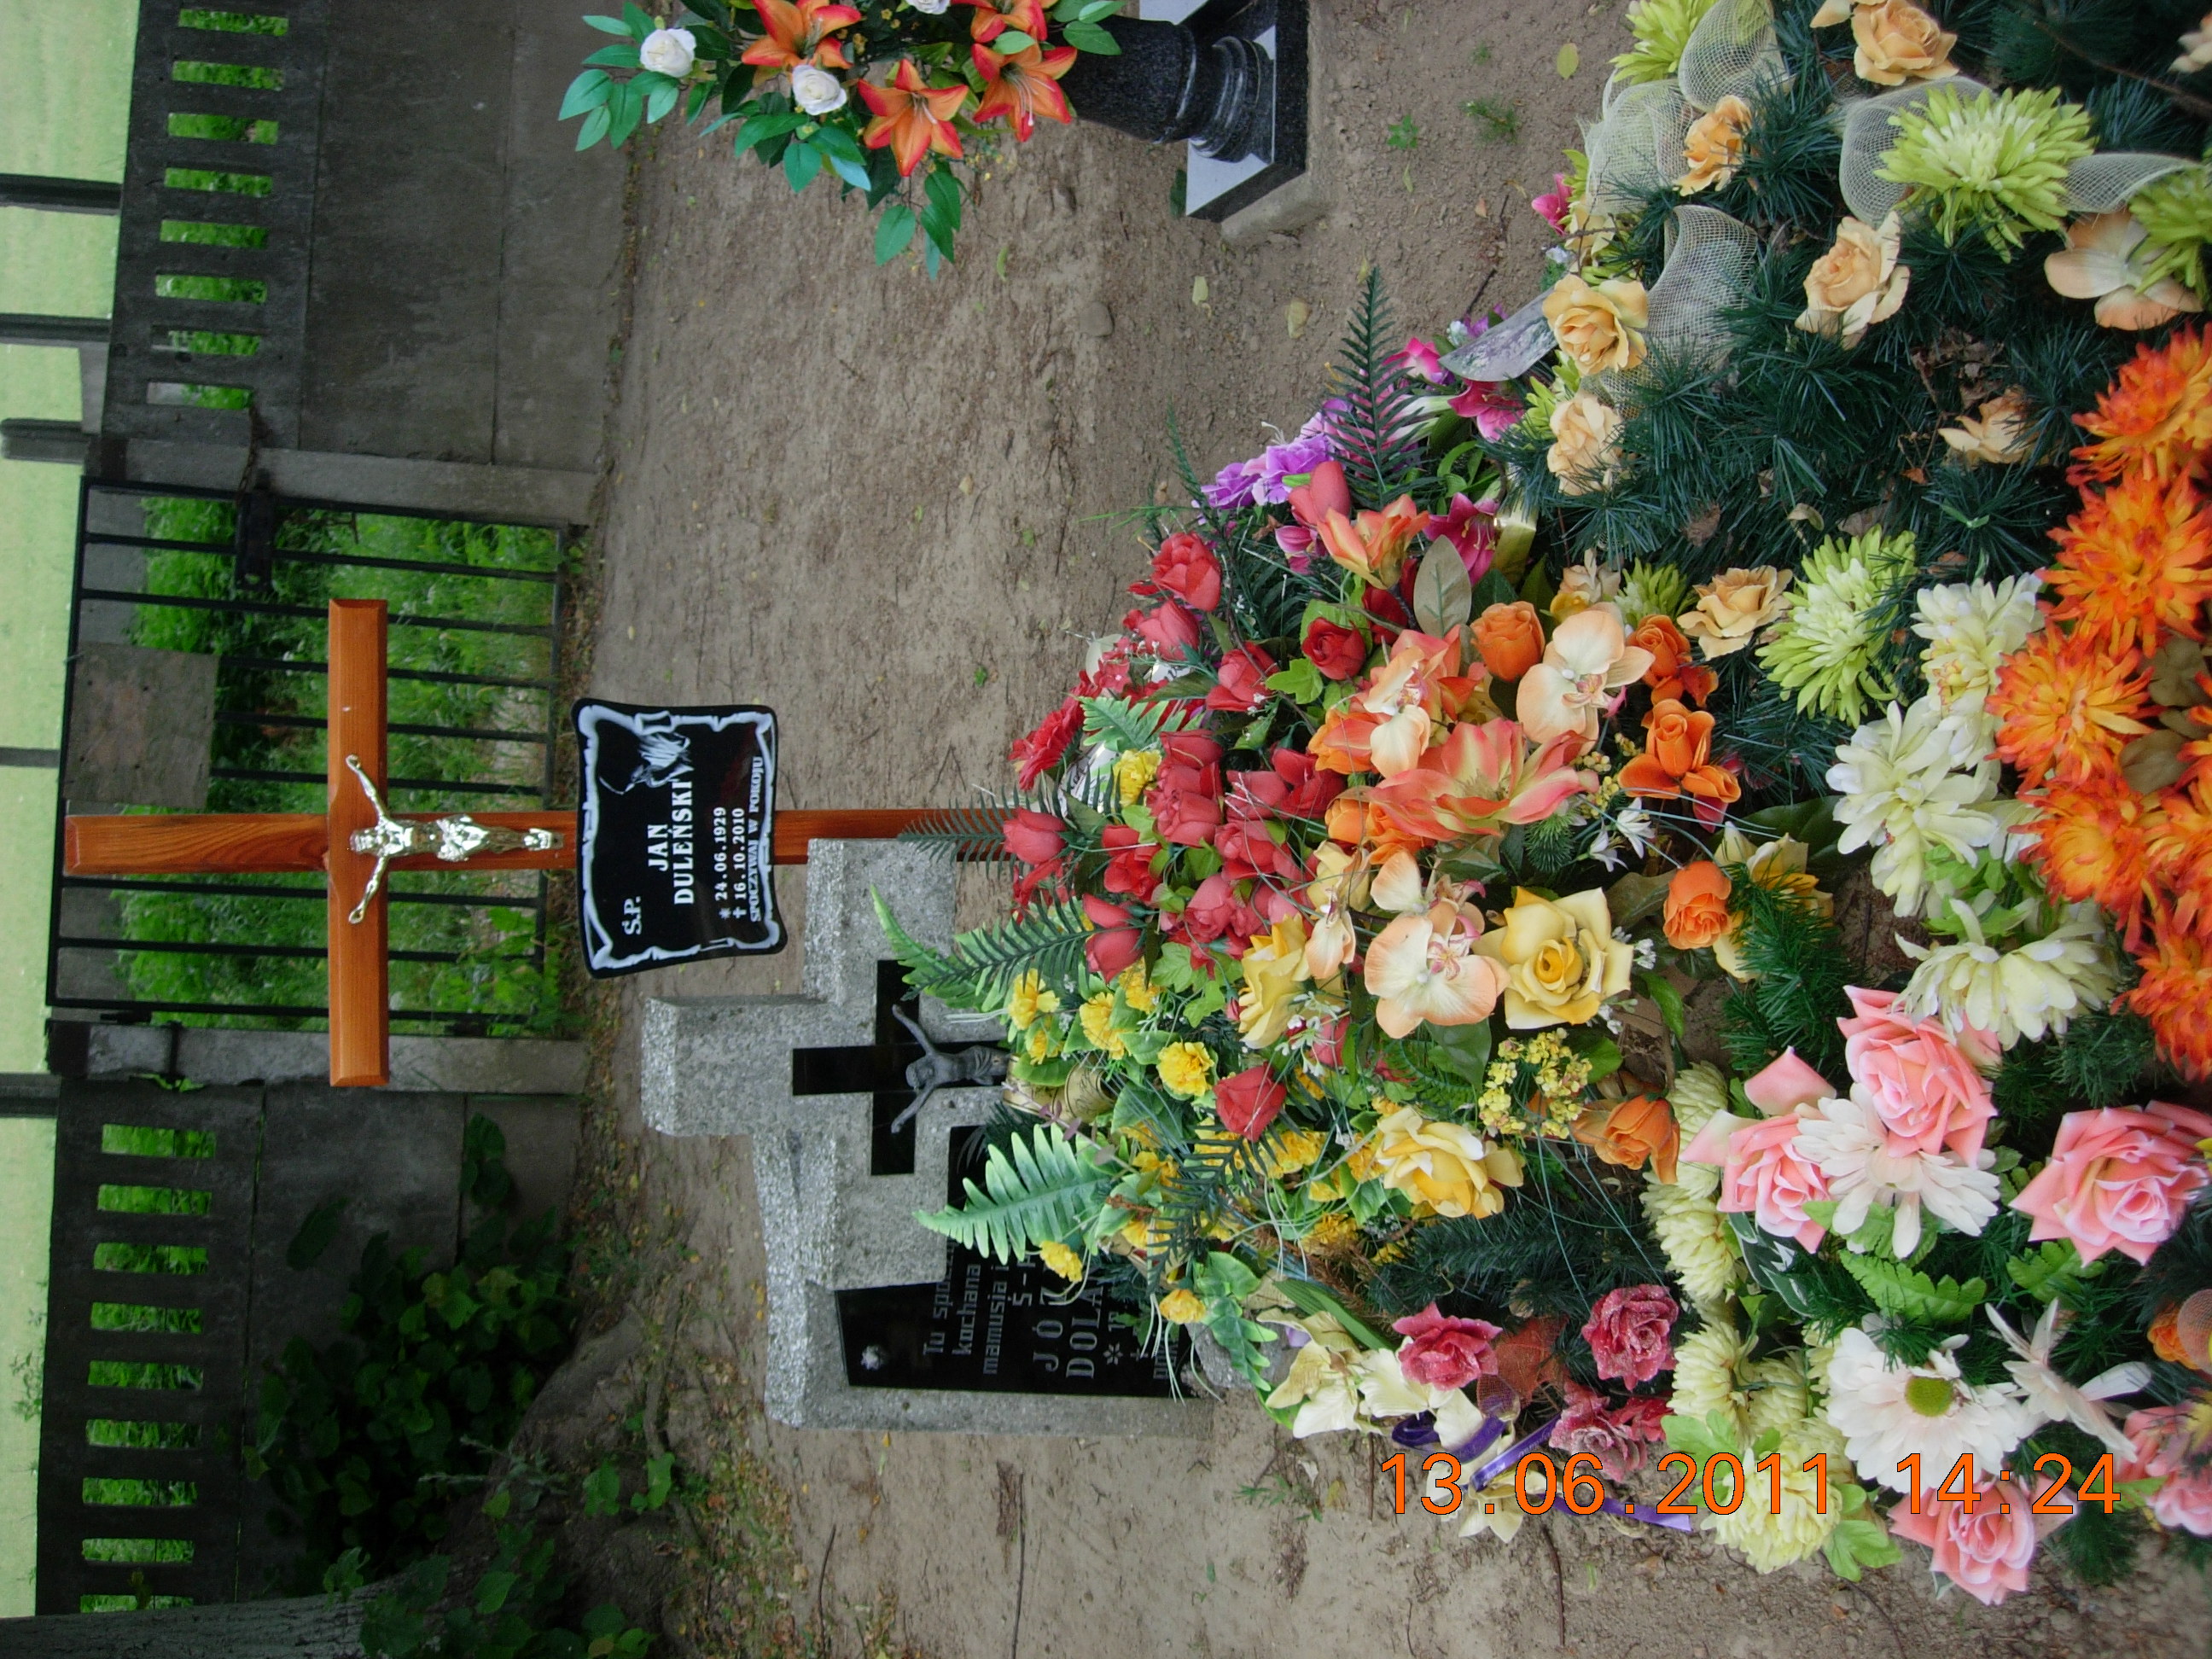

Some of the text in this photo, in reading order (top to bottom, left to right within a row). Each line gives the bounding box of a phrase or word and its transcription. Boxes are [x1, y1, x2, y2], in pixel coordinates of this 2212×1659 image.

[647, 824, 669, 872] JAN
[667, 781, 695, 905] DULEŃSKI
[713, 806, 728, 902] 24.06.1929
[731, 807, 748, 901] 16.10.2010
[748, 756, 765, 923] SPOCZYWAJ W POKOJU
[621, 896, 642, 935] Ś.P.
[922, 1331, 946, 1355] Tu
[952, 1264, 981, 1355] kochana
[982, 1281, 1008, 1376] mamusia
